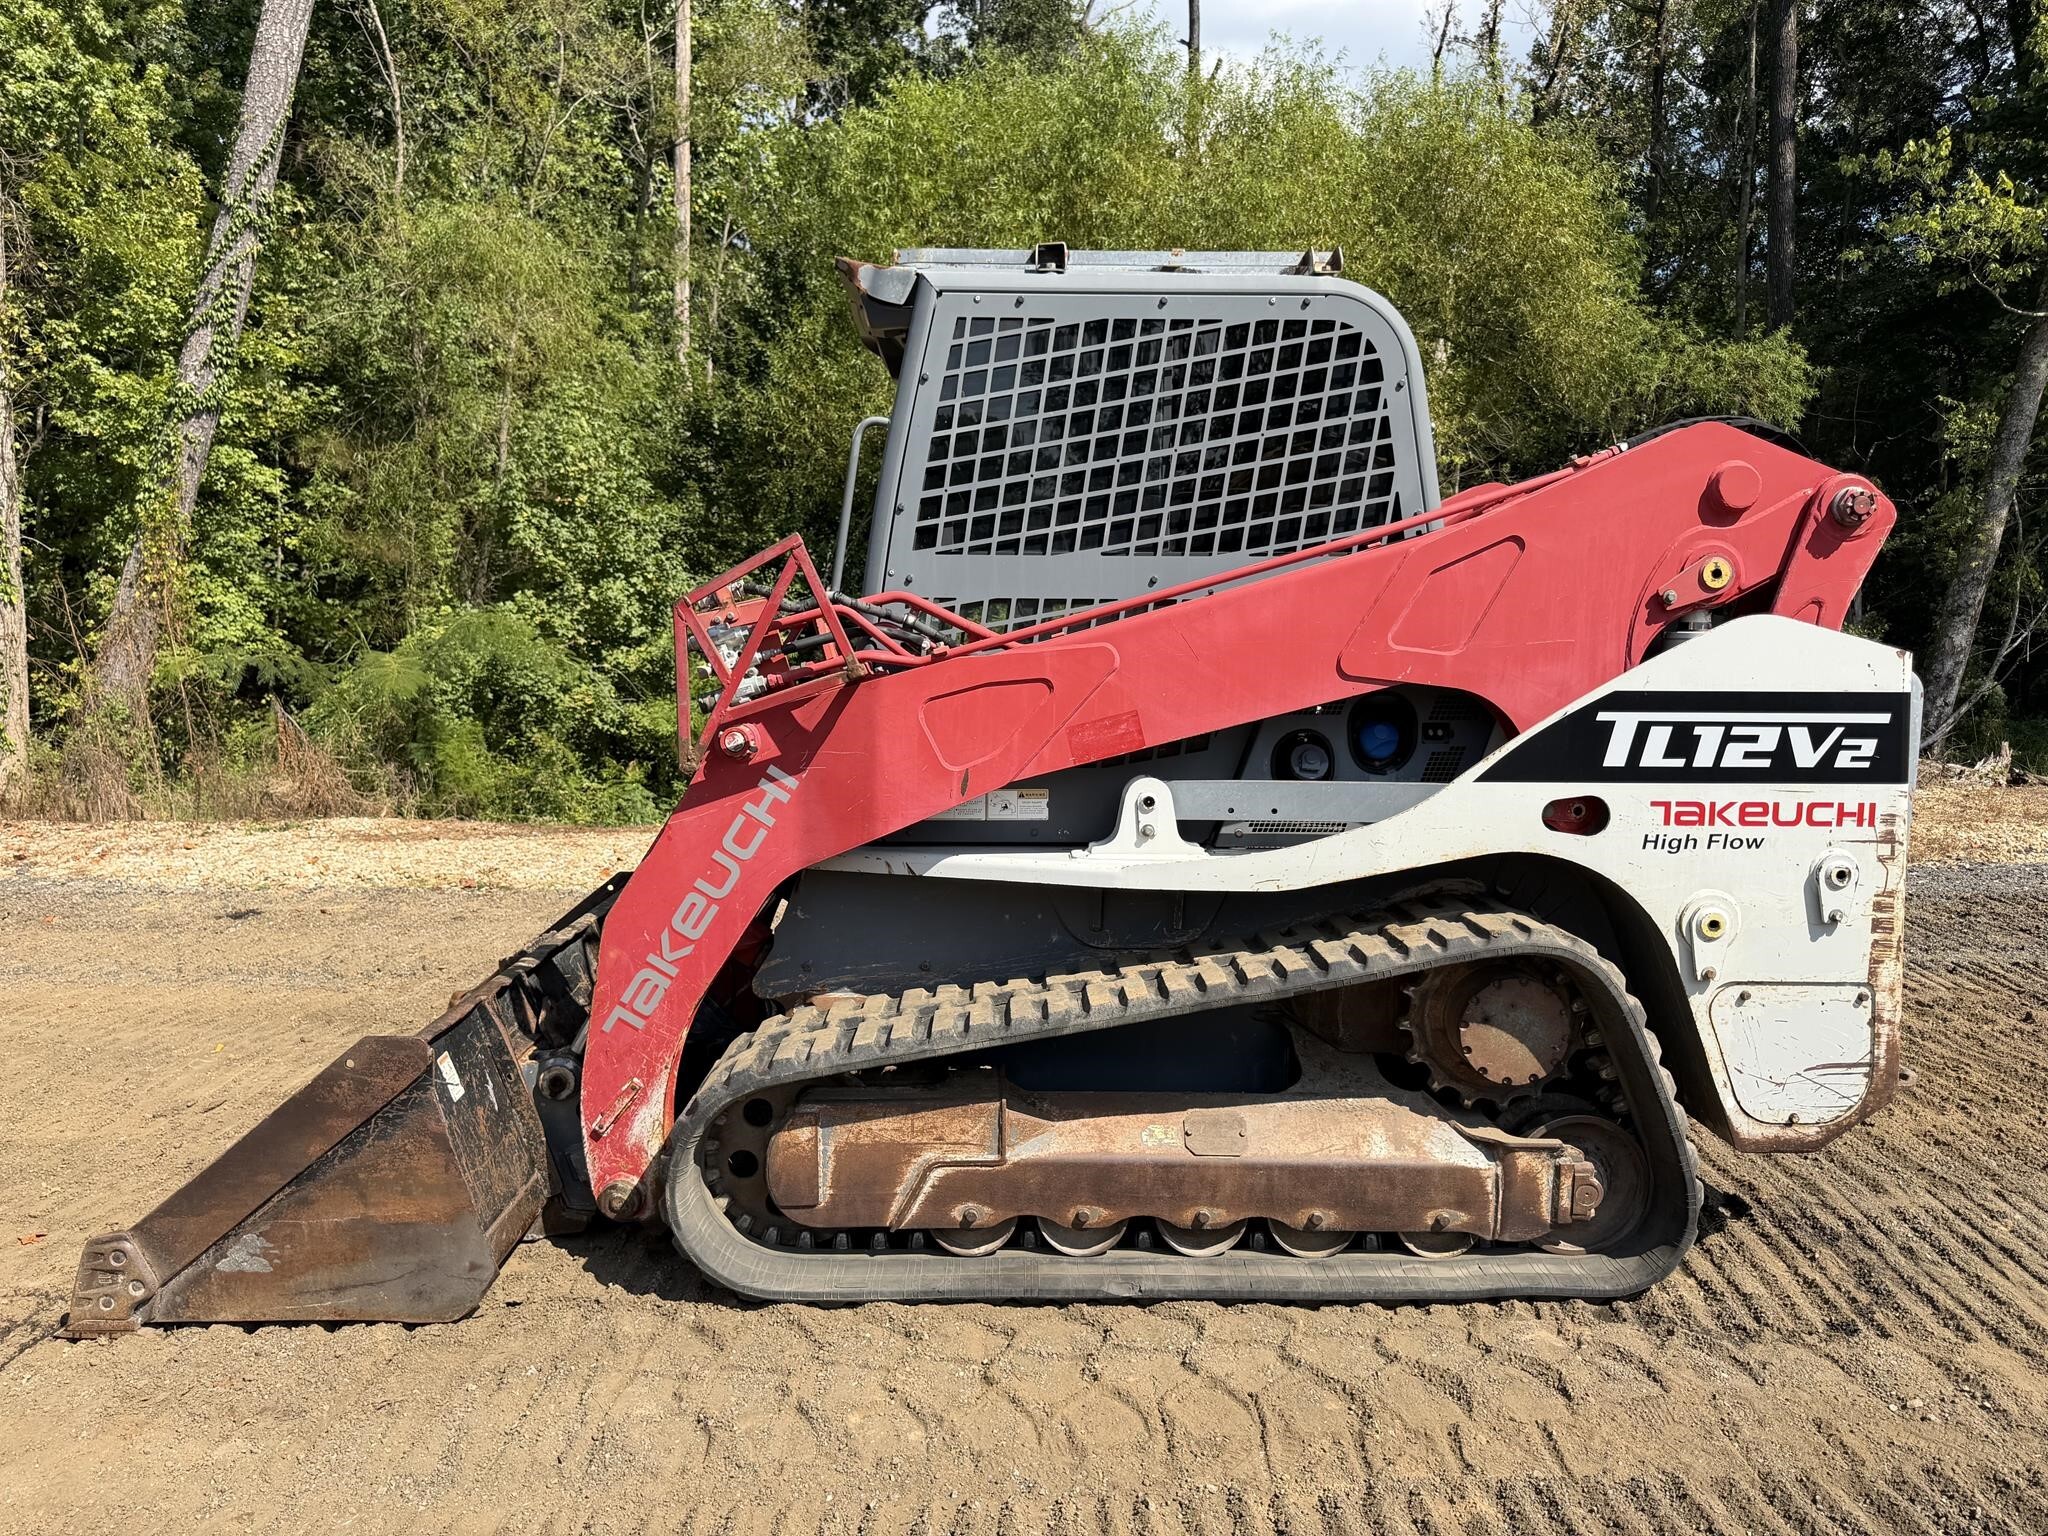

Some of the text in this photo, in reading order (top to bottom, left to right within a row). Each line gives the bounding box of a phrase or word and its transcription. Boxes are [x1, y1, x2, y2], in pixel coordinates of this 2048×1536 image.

[1596, 711, 1891, 769] TL12V2
[1641, 833, 1765, 854] High Flow
